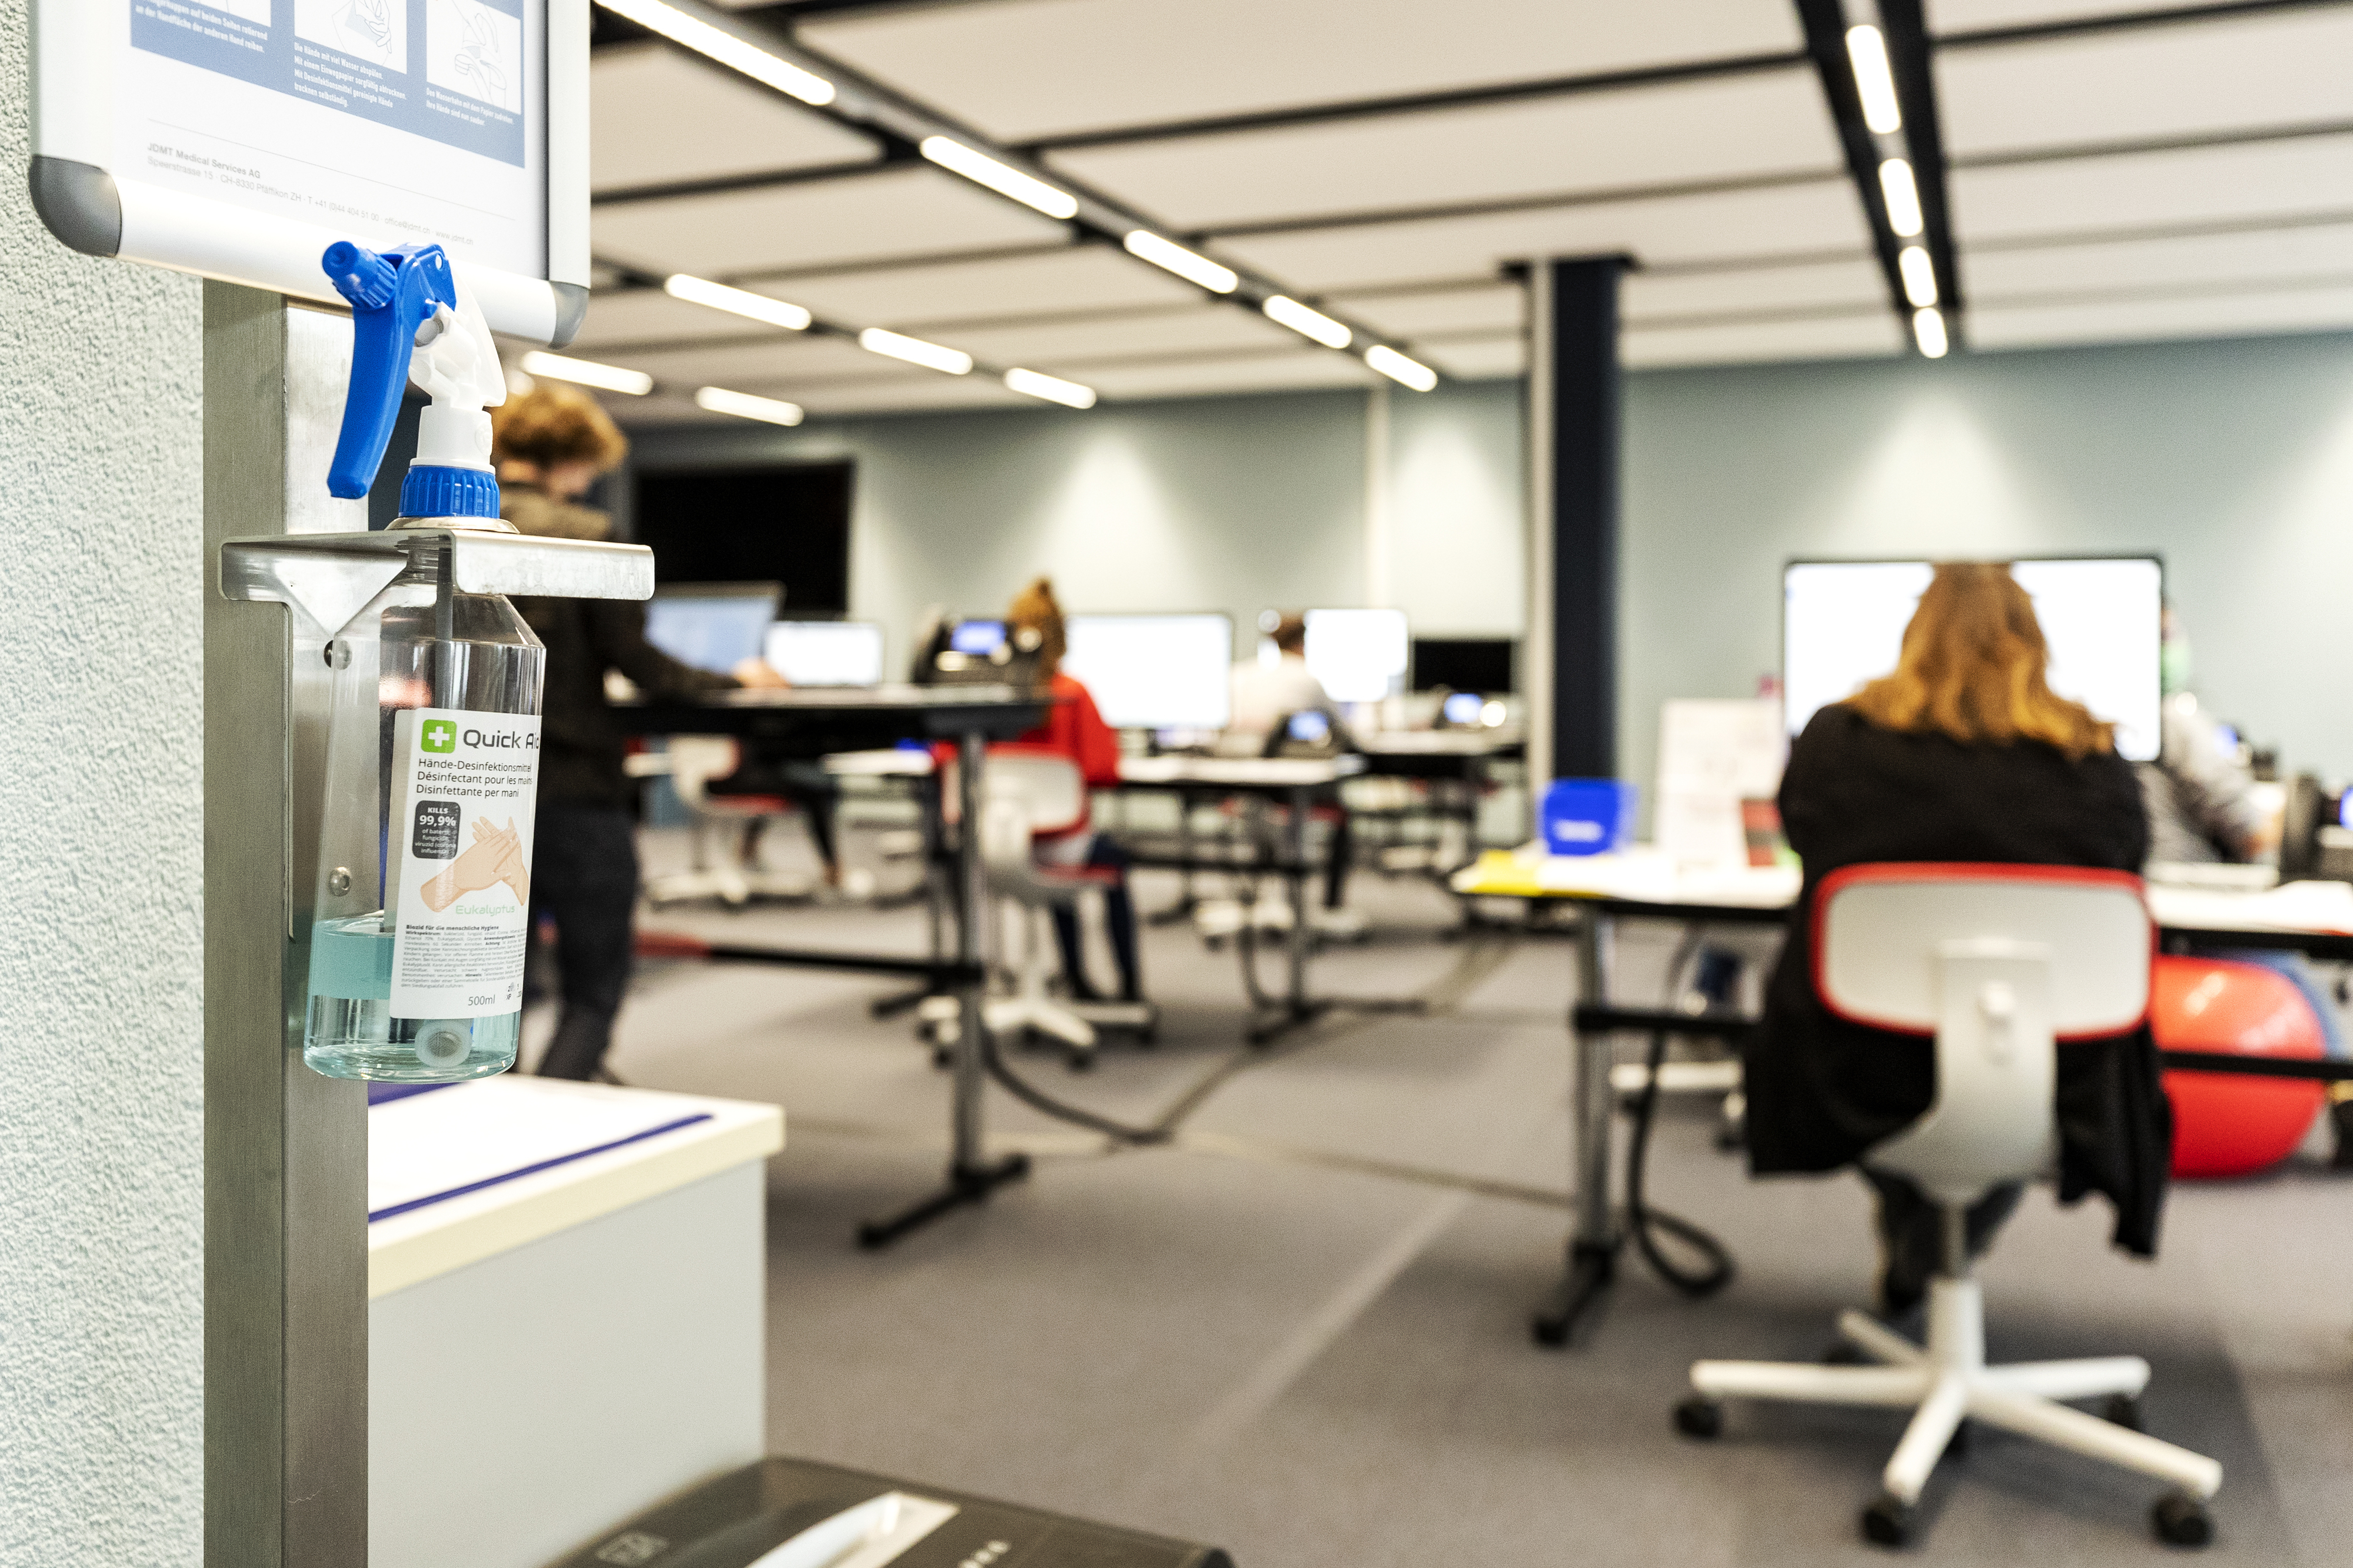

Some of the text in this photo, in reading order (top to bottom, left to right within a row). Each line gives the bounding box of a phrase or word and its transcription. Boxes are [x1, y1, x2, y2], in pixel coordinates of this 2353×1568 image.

[294, 41, 382, 79] Die Hände mit viel Wasser abspülen.
[294, 55, 406, 100] Mit einem Einwegpapier sorgfältig abtrocknen.
[294, 68, 393, 108] Mit Desinfektionsmittel gereinigte Hände
[294, 82, 318, 96] trocknen
[147, 142, 261, 179] JDMT Medical Services AG
[147, 156, 201, 178] Speerstrasse
[204, 171, 214, 180] 15
[219, 174, 254, 191] CH-8330
[290, 191, 302, 202] ZH
[308, 195, 313, 205] T
[315, 200, 327, 208] +41
[329, 202, 345, 213] (0)44
[346, 207, 359, 216] 404
[361, 210, 369, 218] 51
[371, 212, 379, 222] 00
[384, 216, 431, 235] office@jdmt.ch
[435, 229, 474, 246] www.jdmt.ch
[463, 729, 522, 749] Quick
[418, 758, 532, 773] Hände-Desinfektionsmittel
[417, 771, 533, 786] Désinfectant pour les mains
[416, 784, 519, 799] Disinfettante per mani
[419, 815, 456, 828] 99,9%
[456, 905, 515, 917] Eukalyptus
[468, 994, 496, 1006] 500ml
